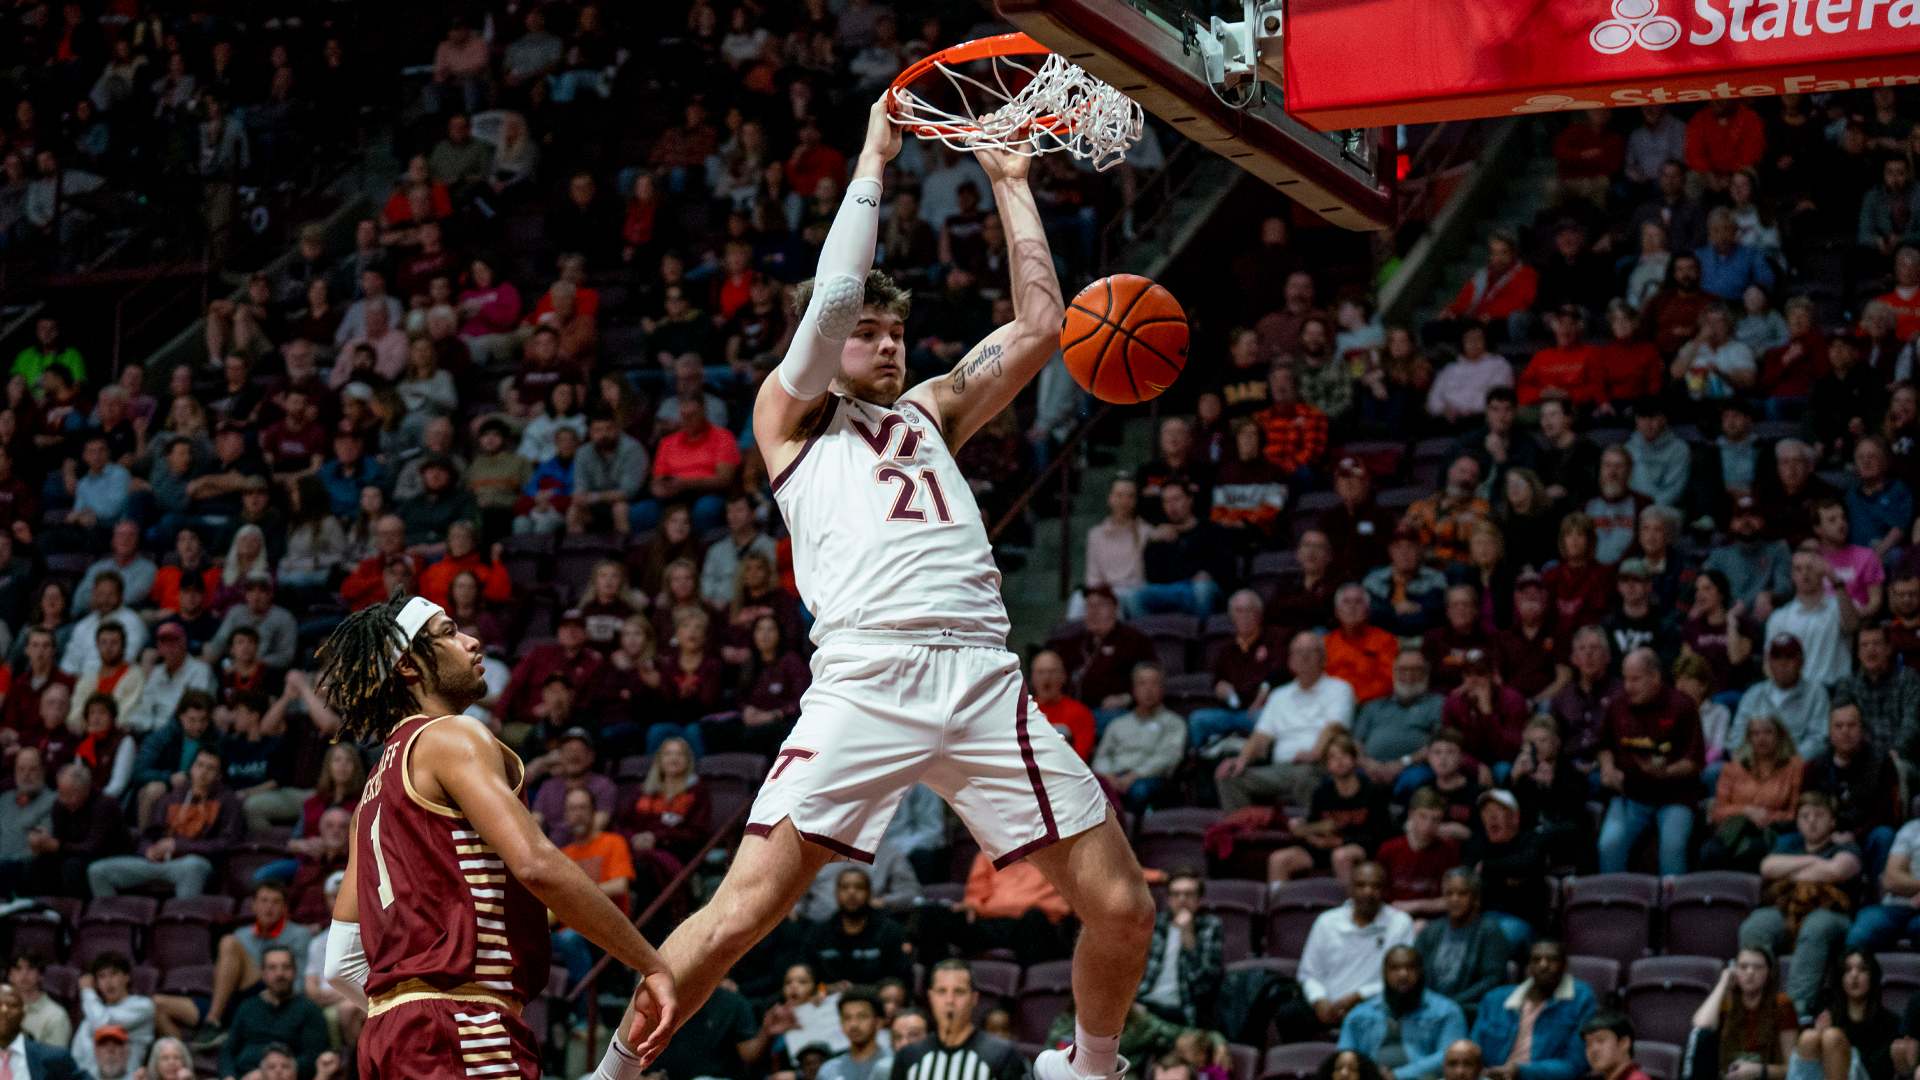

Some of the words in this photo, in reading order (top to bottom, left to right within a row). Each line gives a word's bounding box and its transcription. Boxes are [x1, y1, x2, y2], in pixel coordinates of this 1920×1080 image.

[1610, 82, 1776, 106] State
[952, 344, 1002, 395] Family
[847, 411, 926, 460] VT
[876, 465, 954, 524] 21
[370, 802, 395, 910] 1
